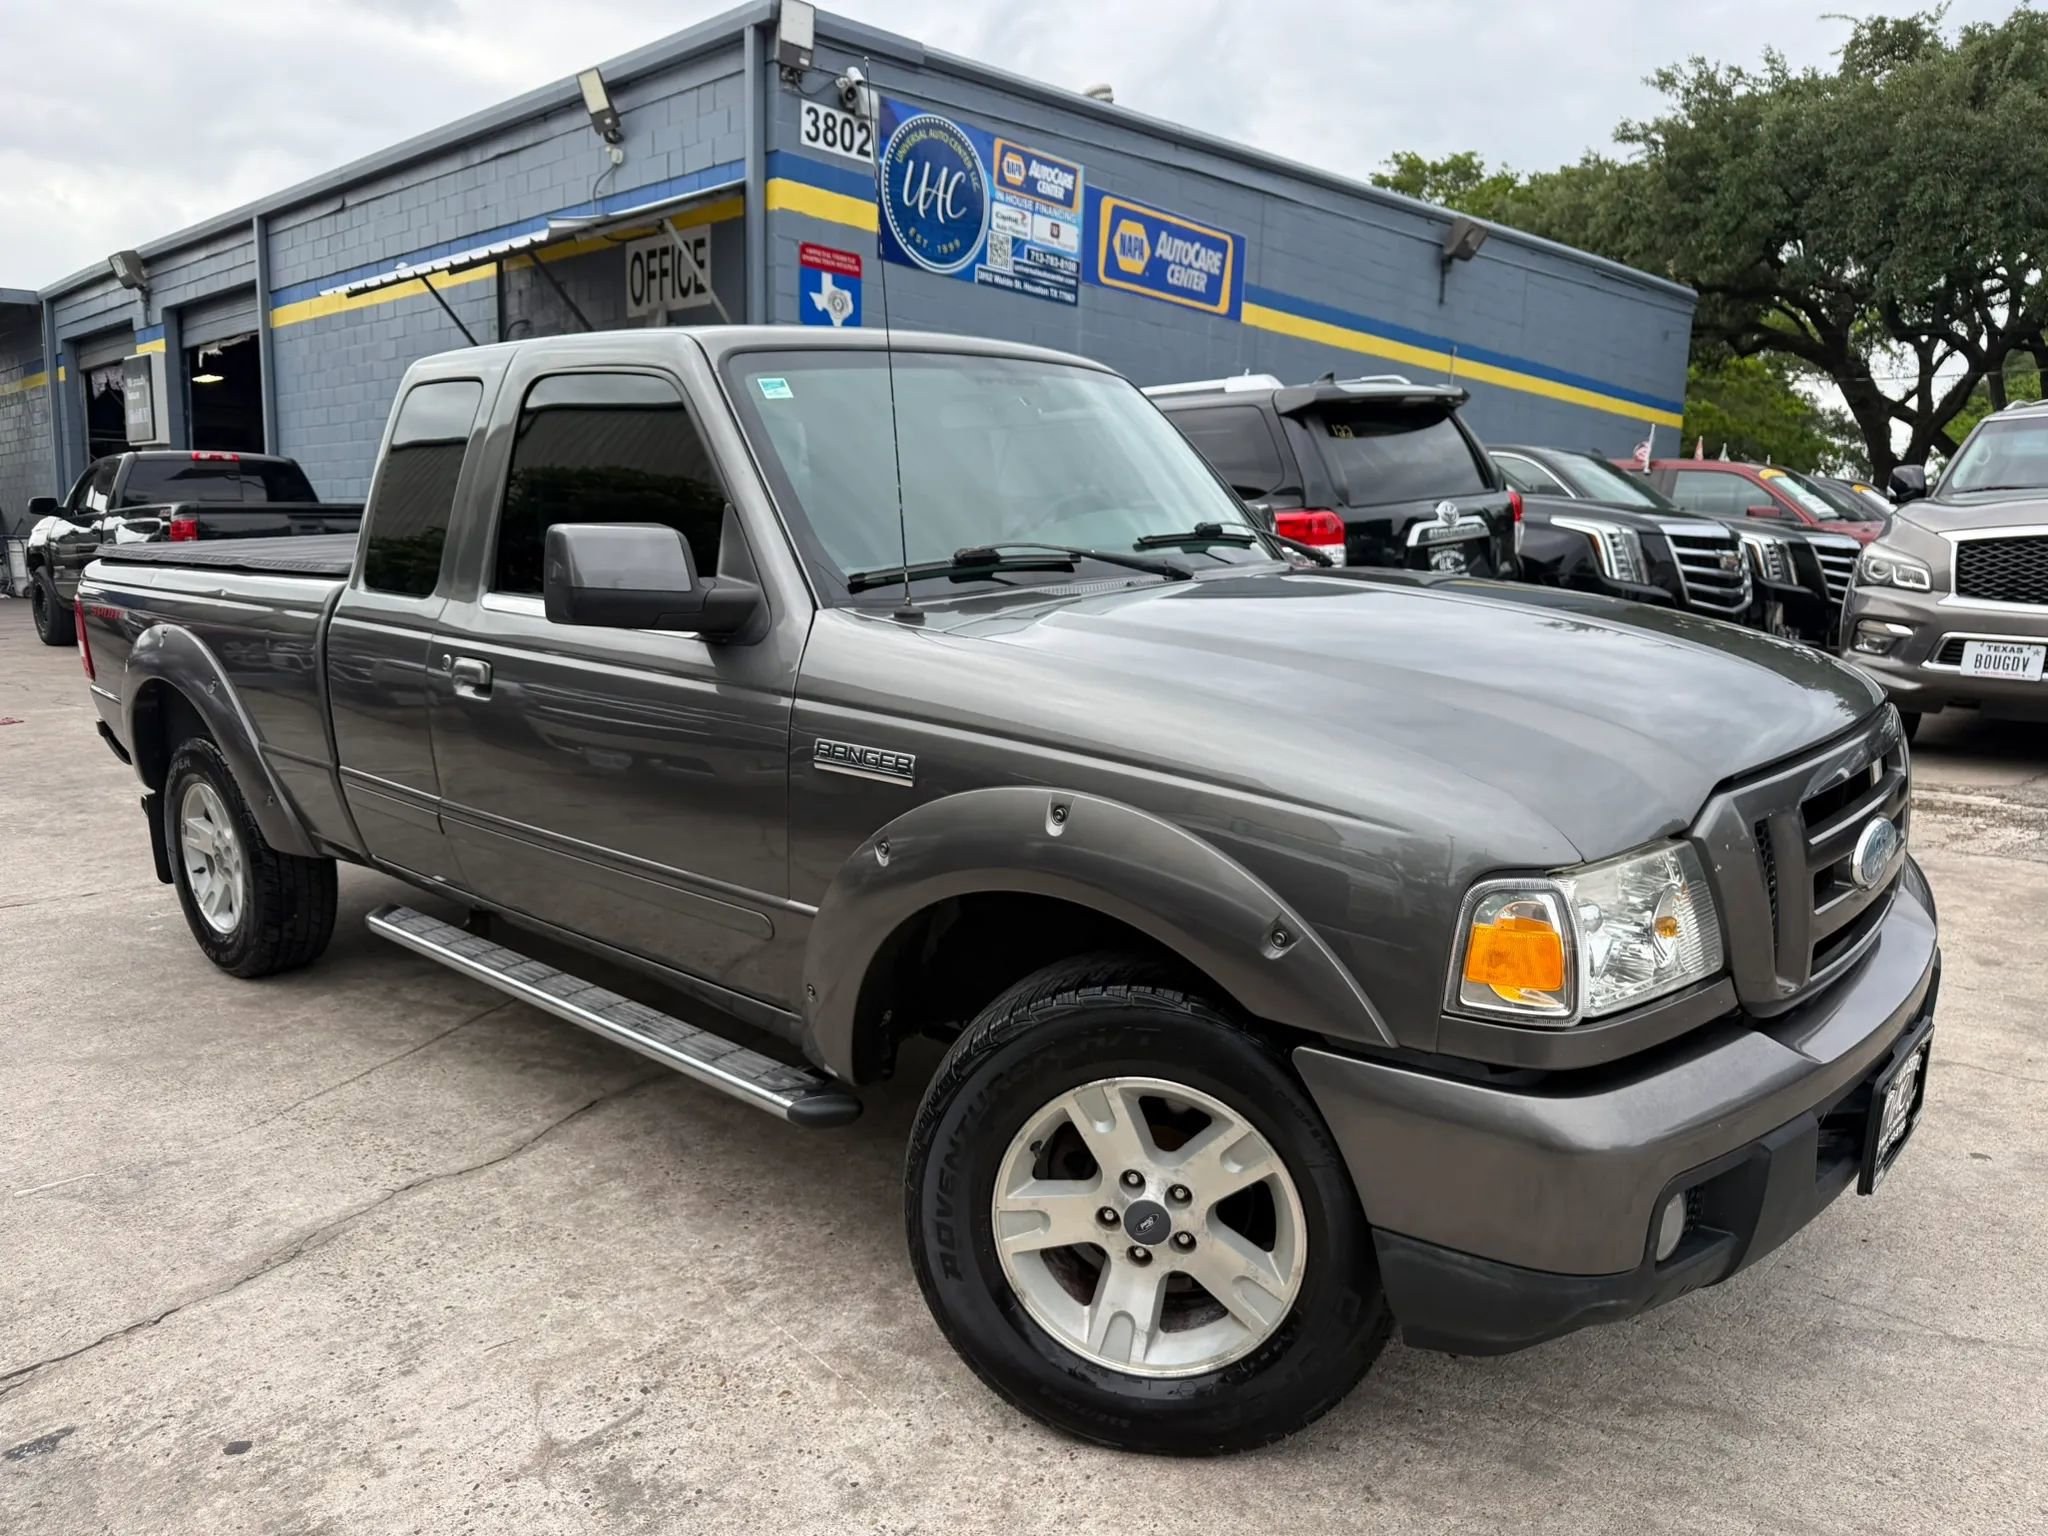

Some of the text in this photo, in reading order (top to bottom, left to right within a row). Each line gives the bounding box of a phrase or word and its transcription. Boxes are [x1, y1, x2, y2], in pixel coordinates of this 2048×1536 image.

[804, 106, 872, 158] 3802
[929, 127, 949, 143] AUTO
[902, 159, 968, 225] UAC
[1036, 180, 1066, 200] CENTER
[994, 190, 1004, 201] IN
[1005, 192, 1034, 211] HOUSE
[1035, 201, 1076, 223] FINANCING
[1119, 233, 1145, 262] NAPA
[629, 236, 707, 307] OFFICE
[1166, 263, 1208, 293] CENTER
[1973, 653, 2031, 673] BOUGDV
[1986, 644, 2024, 654] TEXAS
[815, 739, 913, 775] RANGER
